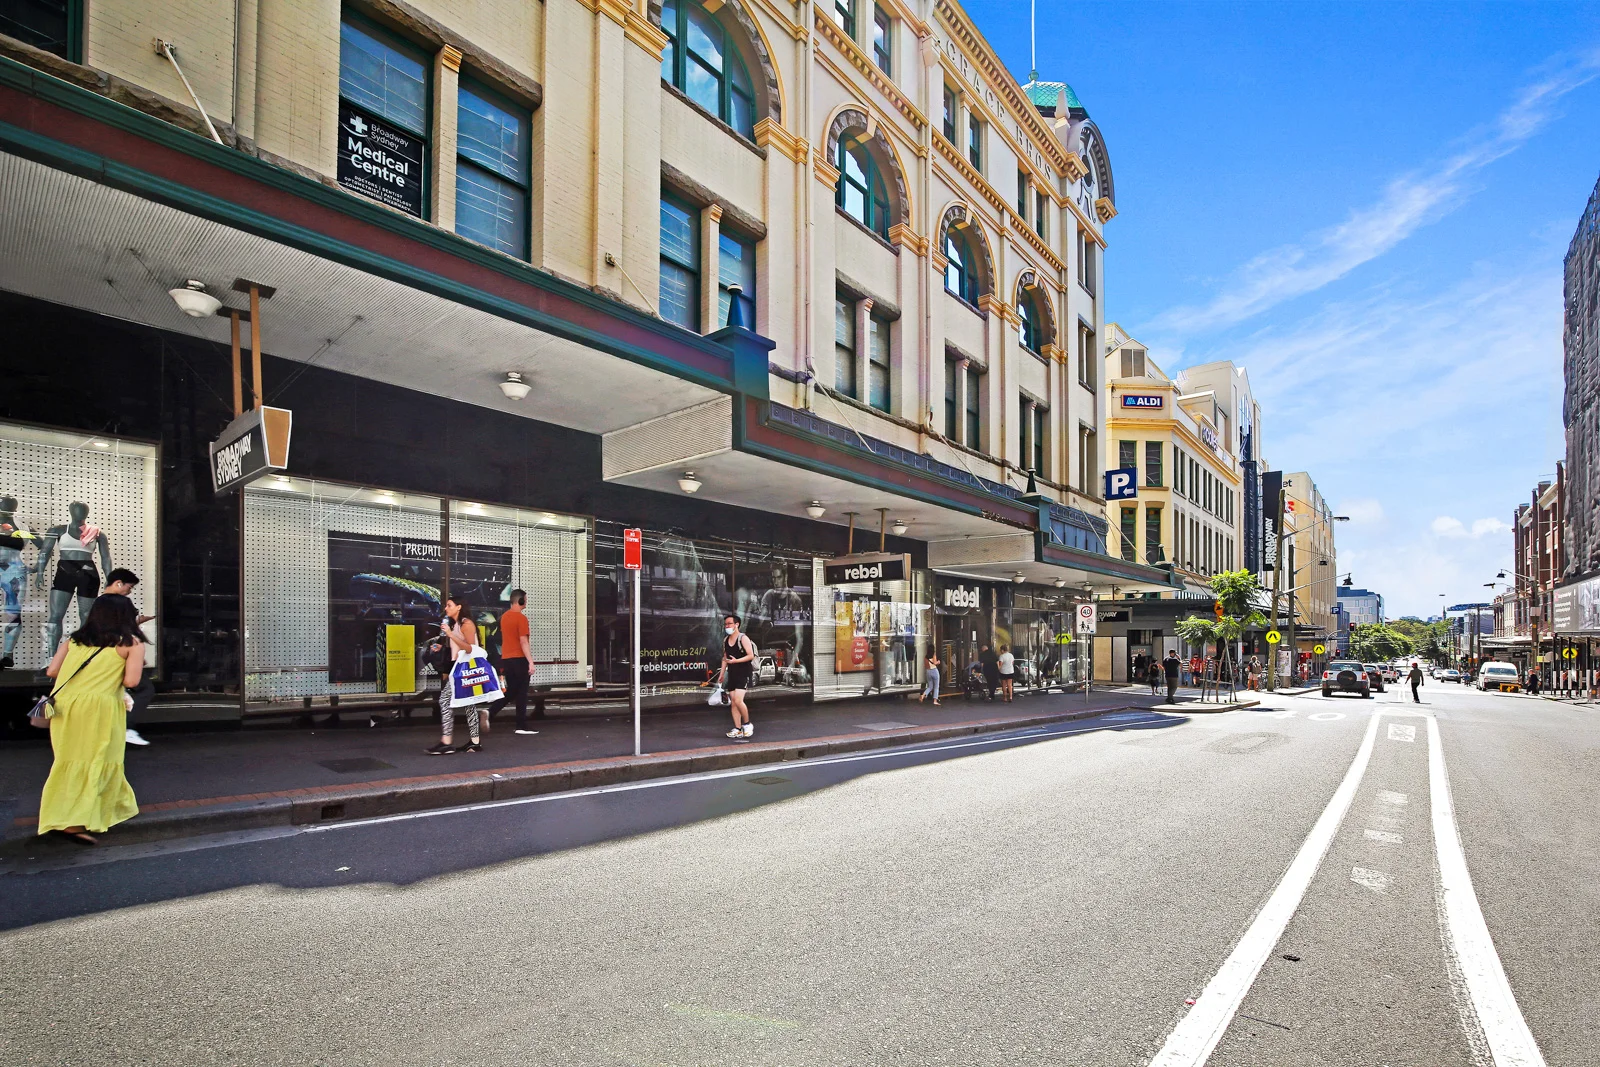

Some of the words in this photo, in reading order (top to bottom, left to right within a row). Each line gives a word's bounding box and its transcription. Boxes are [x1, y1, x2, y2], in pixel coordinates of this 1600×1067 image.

[371, 124, 409, 147] Broadway
[371, 131, 399, 150] Sydney
[348, 136, 409, 175] Medical
[1016, 125, 1051, 180] BROS
[350, 153, 406, 187] Centre
[344, 176, 380, 194] OPTOMETRIST
[383, 193, 412, 207] PATHOLOGY
[345, 182, 383, 201] COMPOUNDING
[383, 198, 411, 212] PHARMACY
[354, 175, 378, 189] DOCTORS
[382, 187, 403, 199] DENTIST
[1136, 397, 1160, 406] ALDI
[217, 432, 252, 469] BROADWAY
[217, 456, 242, 485] SYDNEY
[1111, 473, 1130, 495] P
[1283, 479, 1292, 488] et
[1265, 517, 1274, 564] BROADWAY
[844, 563, 883, 580] rebel
[944, 584, 980, 608] rebel
[640, 647, 660, 659] shop
[661, 647, 679, 657] with
[690, 647, 707, 656] 24/7
[640, 661, 707, 673] rebelsport.com
